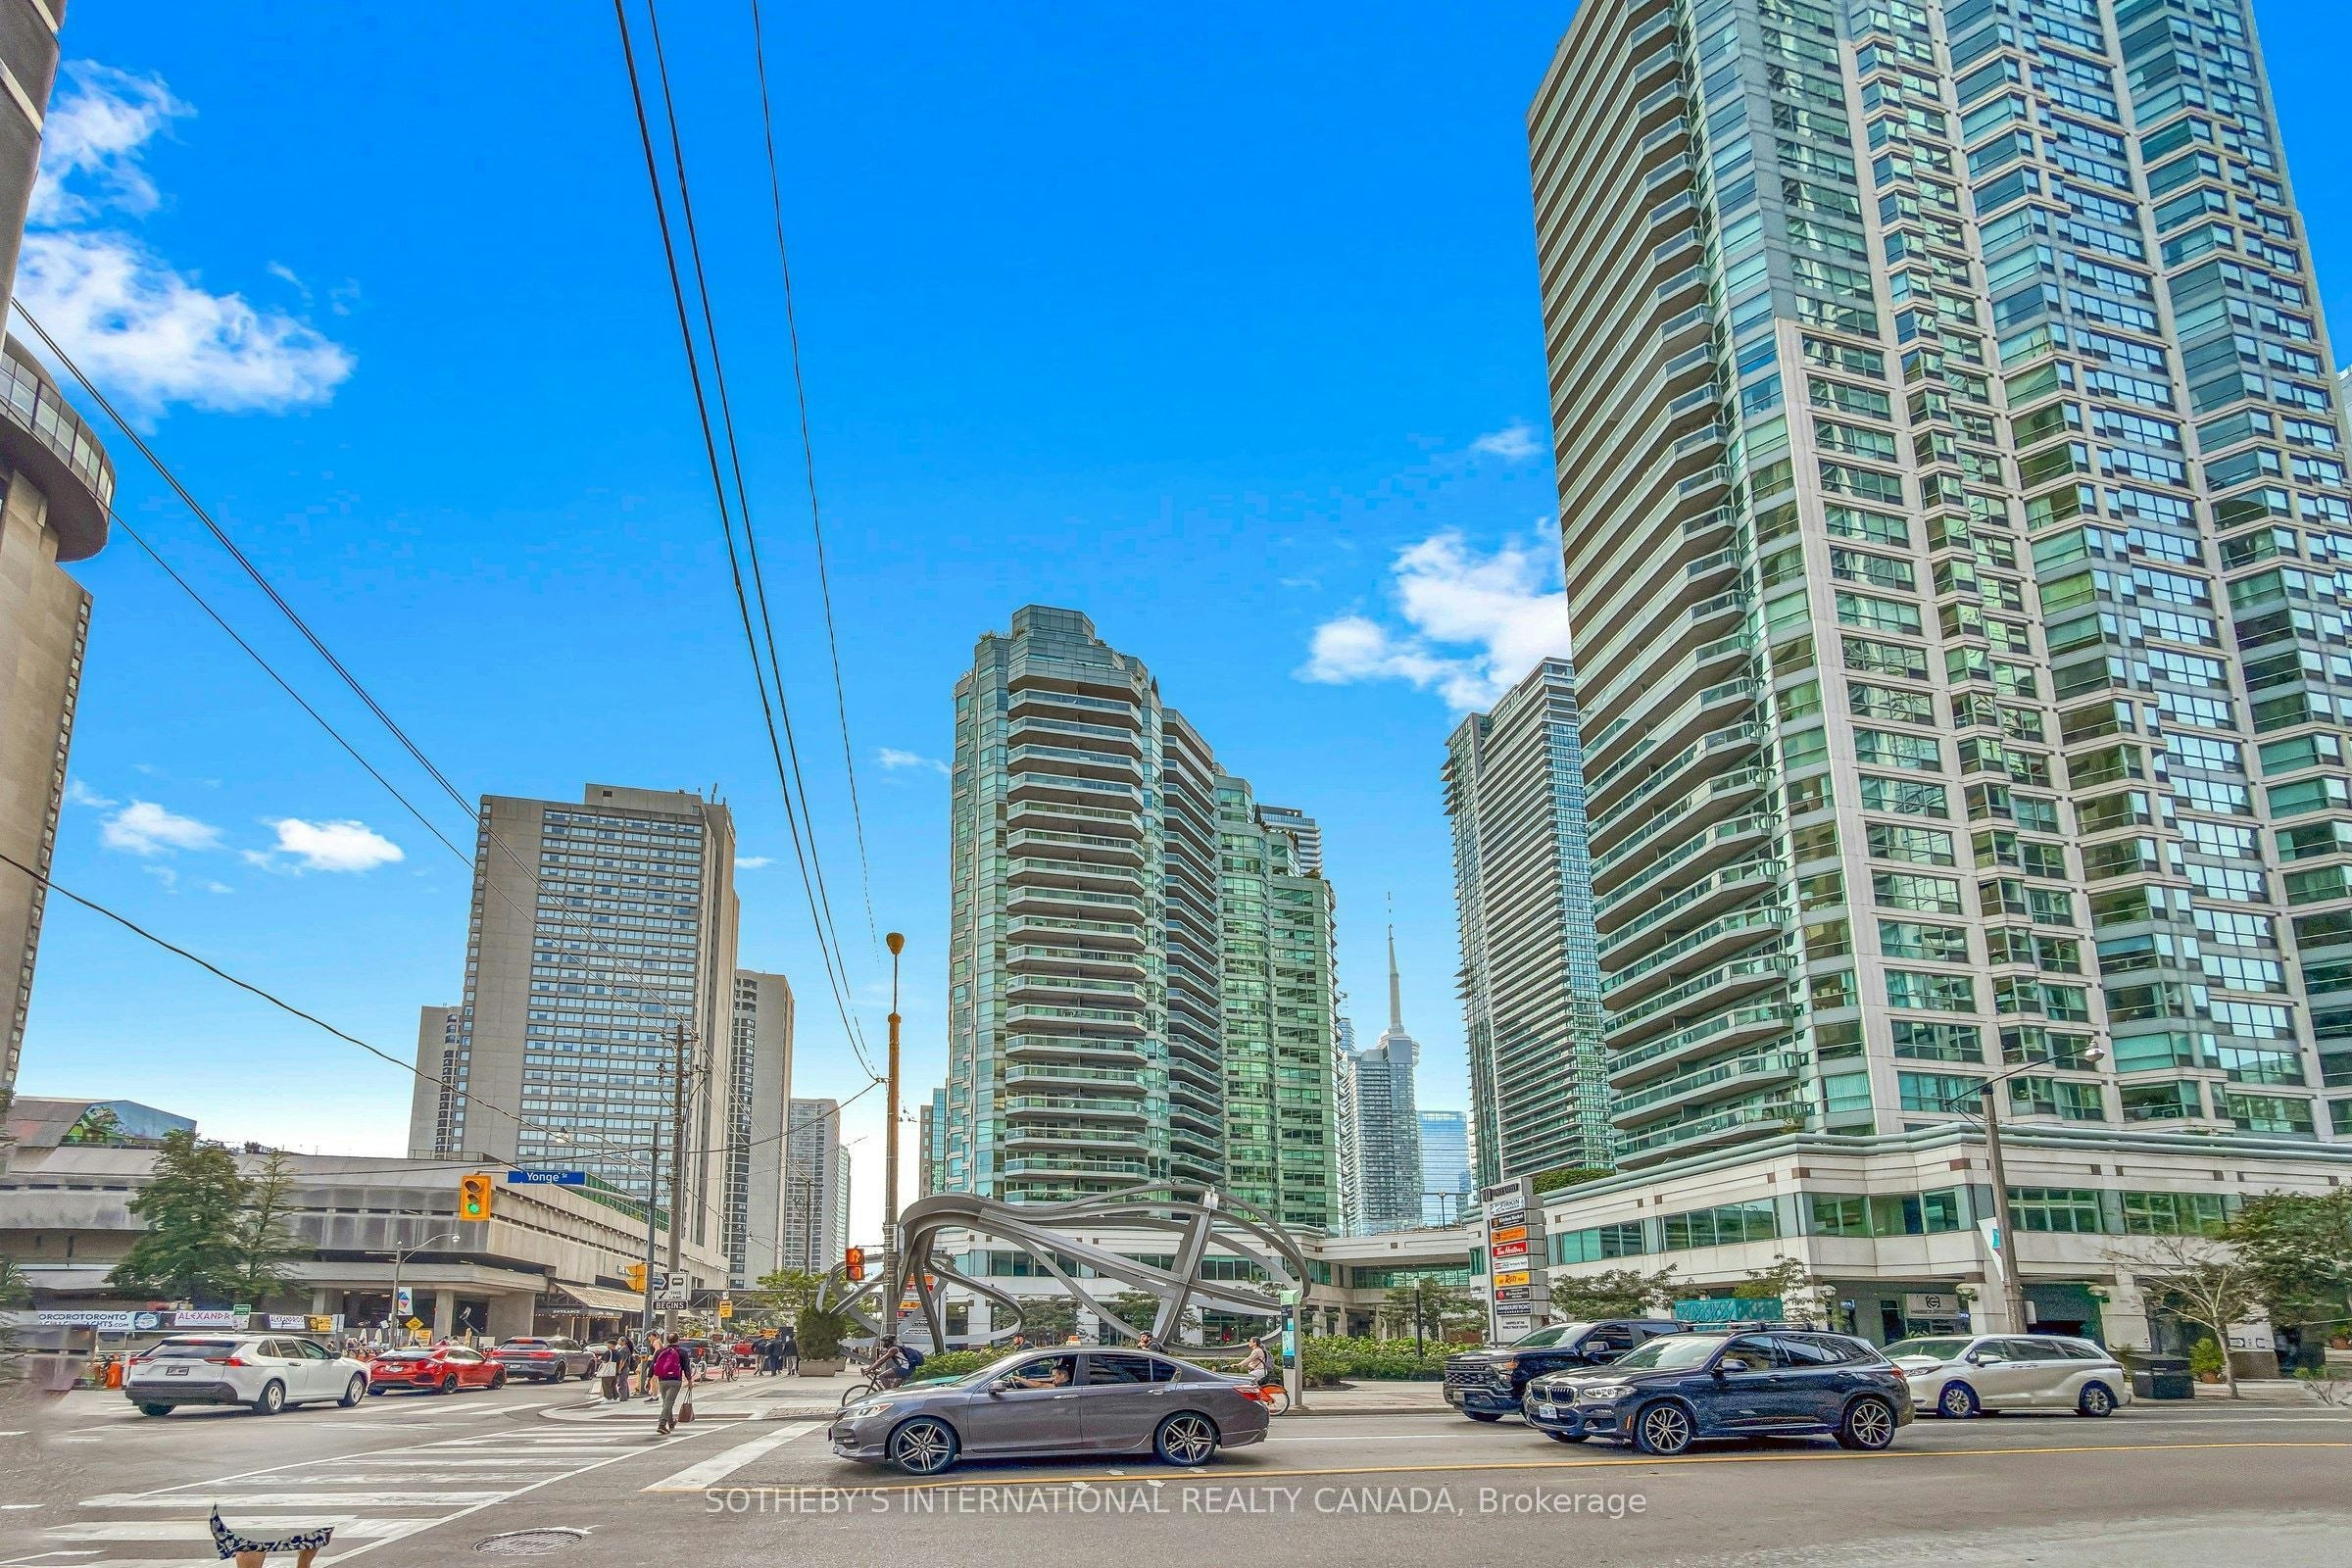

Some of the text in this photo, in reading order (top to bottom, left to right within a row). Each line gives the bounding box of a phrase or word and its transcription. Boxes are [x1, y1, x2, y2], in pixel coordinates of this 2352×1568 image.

[526, 1172, 560, 1184] Yonge
[1482, 1188, 1493, 1202] 10
[1505, 1246, 1524, 1254] Hortons
[177, 1311, 233, 1320] ALEXANDR
